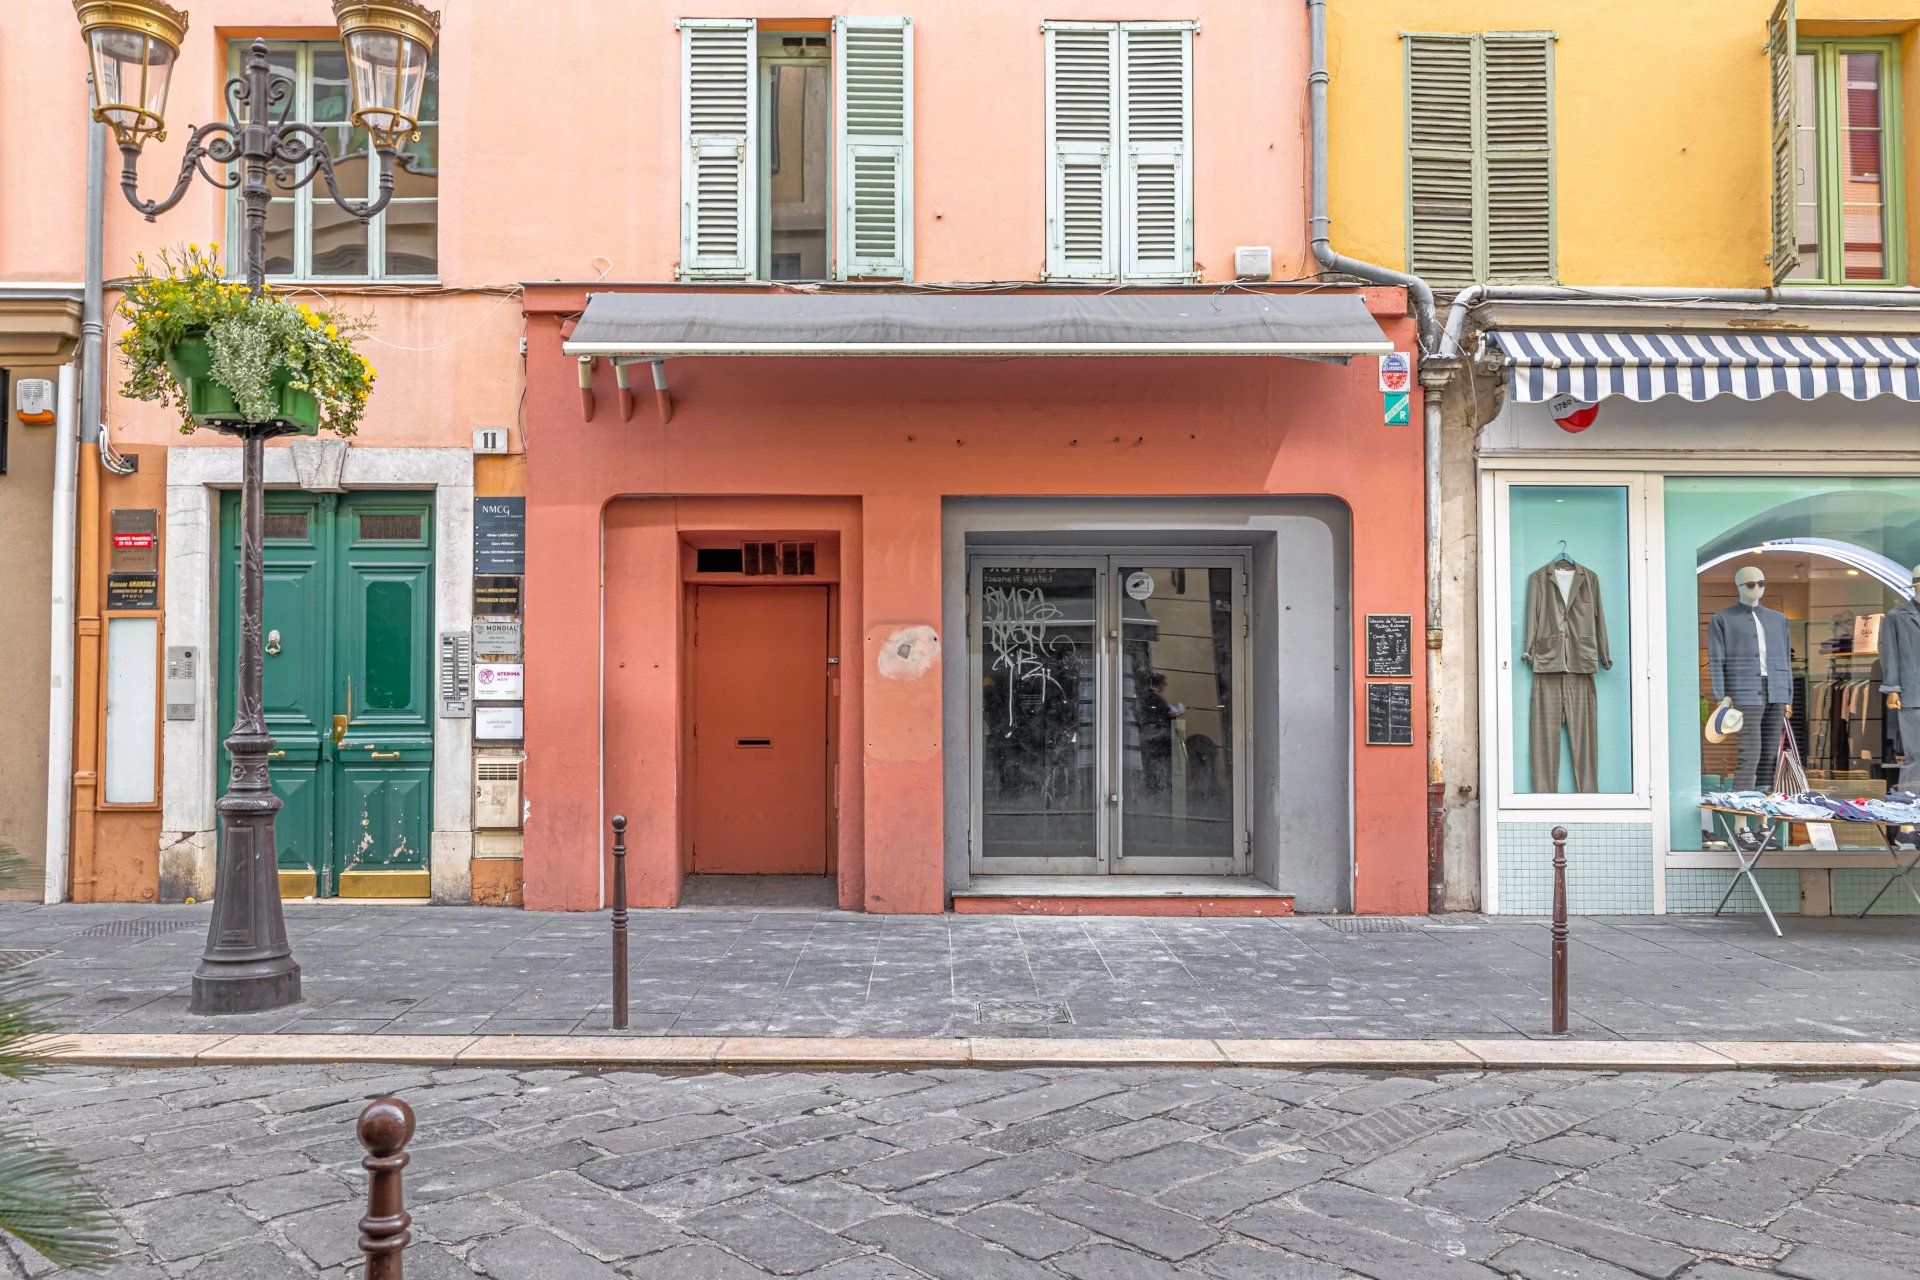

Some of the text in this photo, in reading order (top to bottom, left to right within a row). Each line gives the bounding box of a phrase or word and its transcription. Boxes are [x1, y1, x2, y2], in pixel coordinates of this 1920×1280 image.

[1553, 399, 1572, 412] 1789
[1400, 410, 1406, 420] R
[483, 432, 497, 449] 11
[482, 505, 510, 516] NMCG
